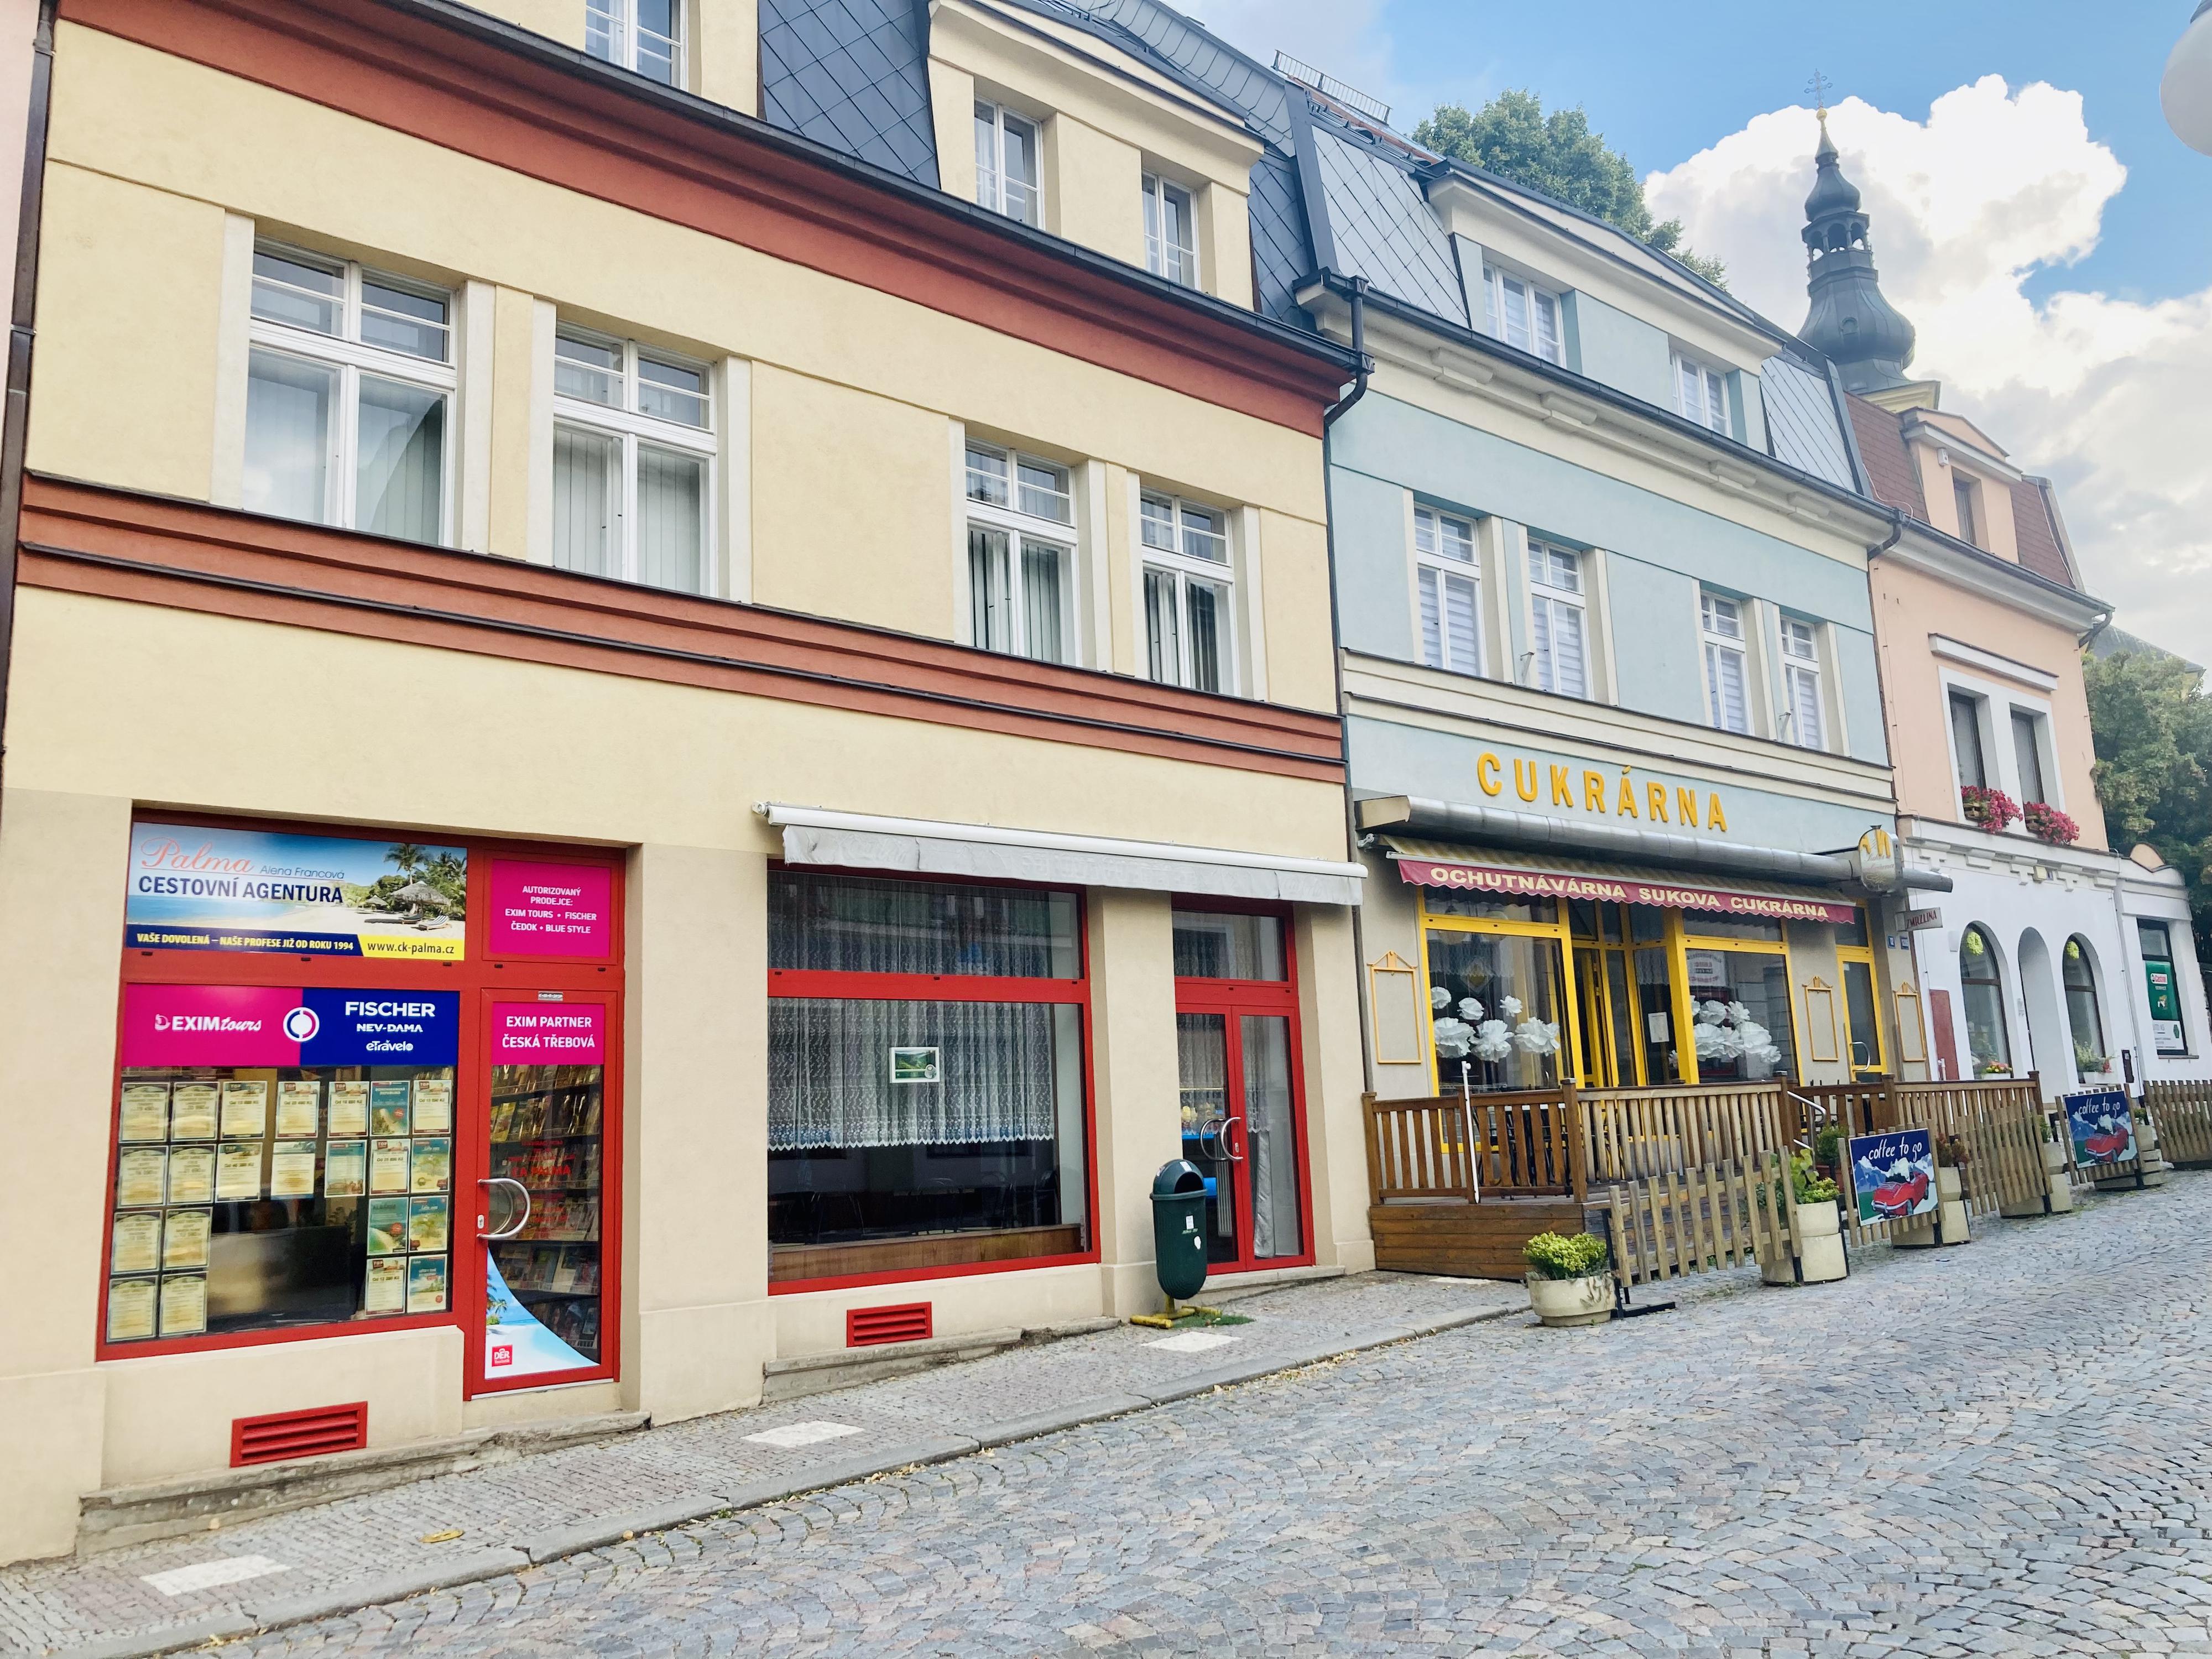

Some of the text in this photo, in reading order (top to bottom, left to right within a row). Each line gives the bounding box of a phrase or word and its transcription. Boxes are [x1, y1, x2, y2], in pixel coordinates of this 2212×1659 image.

[1477, 752, 1728, 832] CUKRÁRNA
[140, 836, 255, 873] Palma
[260, 865, 345, 880] Alena Francová
[139, 875, 343, 904] CESTOVNÍ AGENTURA
[522, 885, 581, 896] AUTORIZOVANÝ
[1430, 867, 1829, 919] OCHUTNÁVÁRNA SUKOVA CUKRÁRNA
[530, 896, 573, 906] PRODEJCE:
[505, 908, 597, 921] EXIM TOURS FISCHER
[510, 921, 591, 934] ČEDOK BLUE STYLE
[137, 932, 354, 950] VAŠE DOVOLENÁ NAŠE PROFESE JIŽ OD ROKU 1994
[367, 941, 455, 955] www.ck-palma.cz
[345, 1001, 436, 1018] FISCHER
[356, 1023, 424, 1032] NEV-DAMA
[506, 1015, 592, 1028] EXIM PARTNER
[502, 1033, 596, 1048] ČESKÁ TŘEBOVÁ
[2078, 1096, 2120, 1119] coffee to go
[1868, 1136, 1922, 1163] coffee to go
